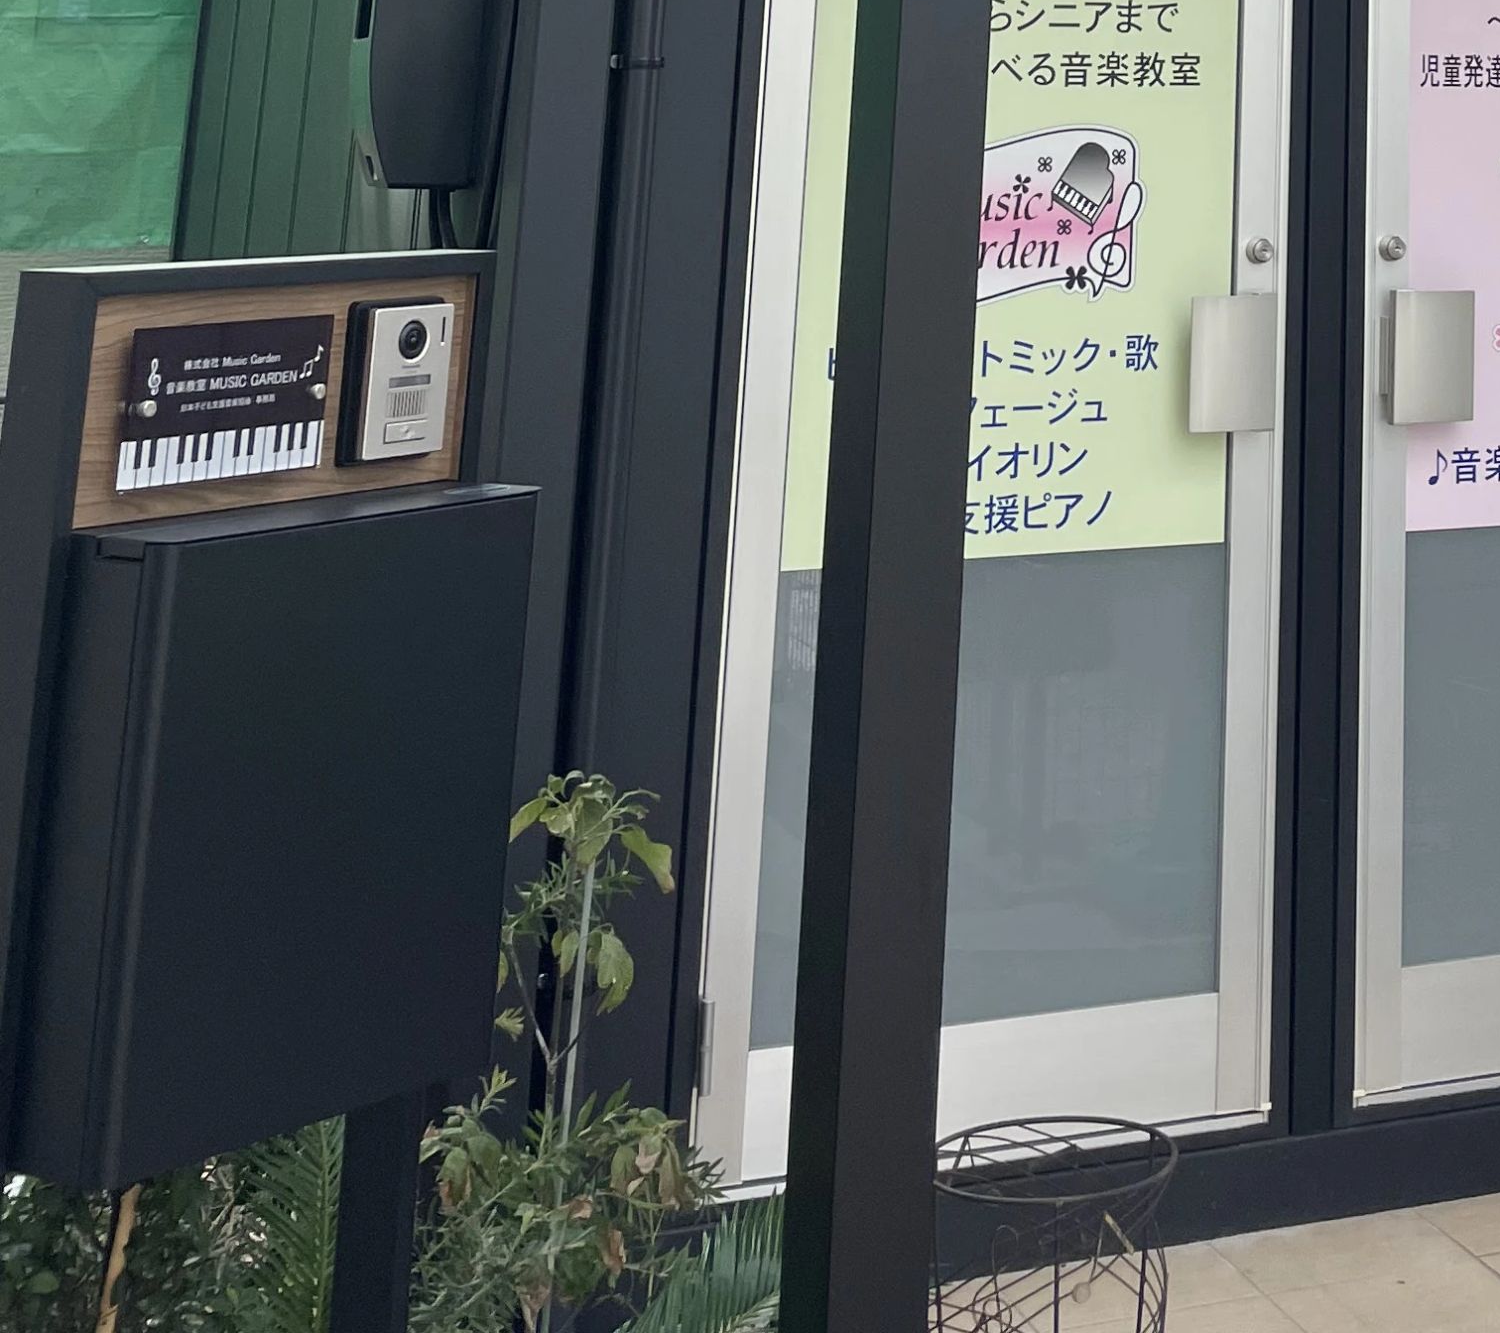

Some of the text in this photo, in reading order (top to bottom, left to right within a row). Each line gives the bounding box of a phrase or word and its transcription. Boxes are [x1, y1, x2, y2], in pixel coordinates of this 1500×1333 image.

[991, 51, 1201, 88] べる音楽教室
[209, 374, 247, 391] MUSIC
[250, 370, 298, 387] GARDEN
